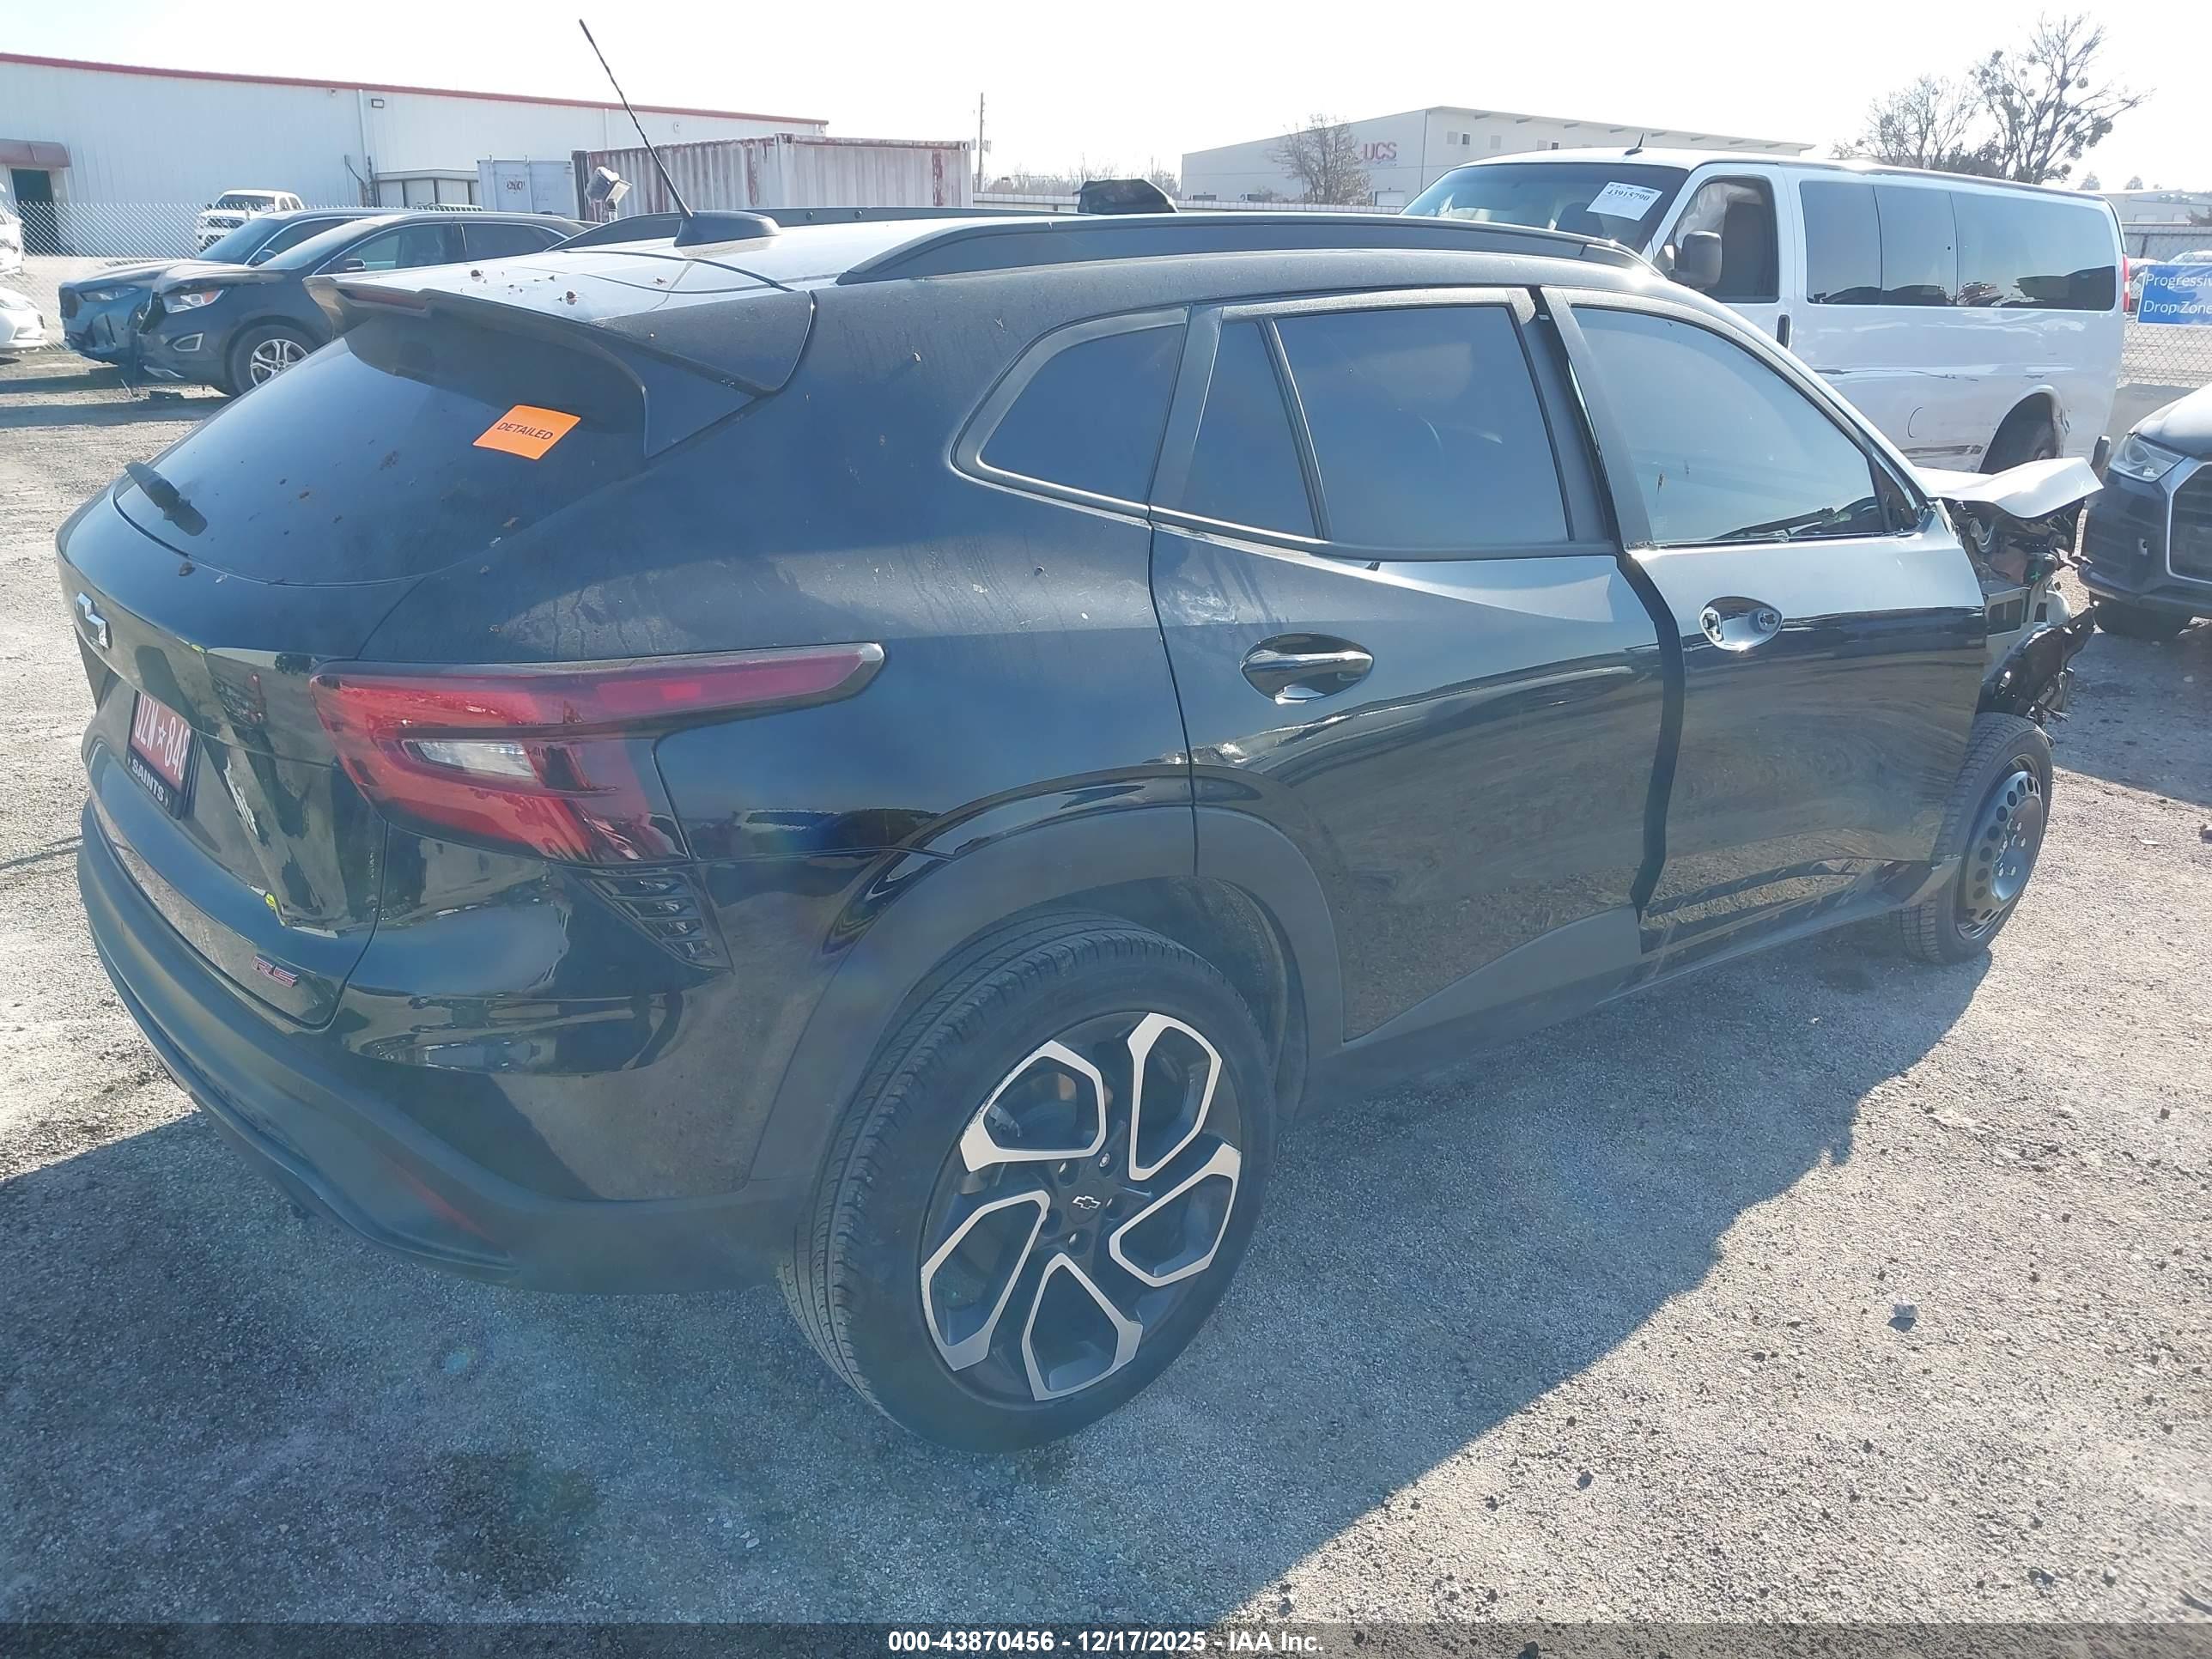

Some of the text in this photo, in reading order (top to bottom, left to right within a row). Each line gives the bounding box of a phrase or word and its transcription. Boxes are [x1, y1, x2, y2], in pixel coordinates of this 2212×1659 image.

[1364, 142, 1397, 160] UCS
[2143, 300, 2212, 316] Drop Zone
[496, 422, 554, 441] DETAILED
[131, 758, 166, 802] SAINTS
[252, 955, 299, 988] RS
